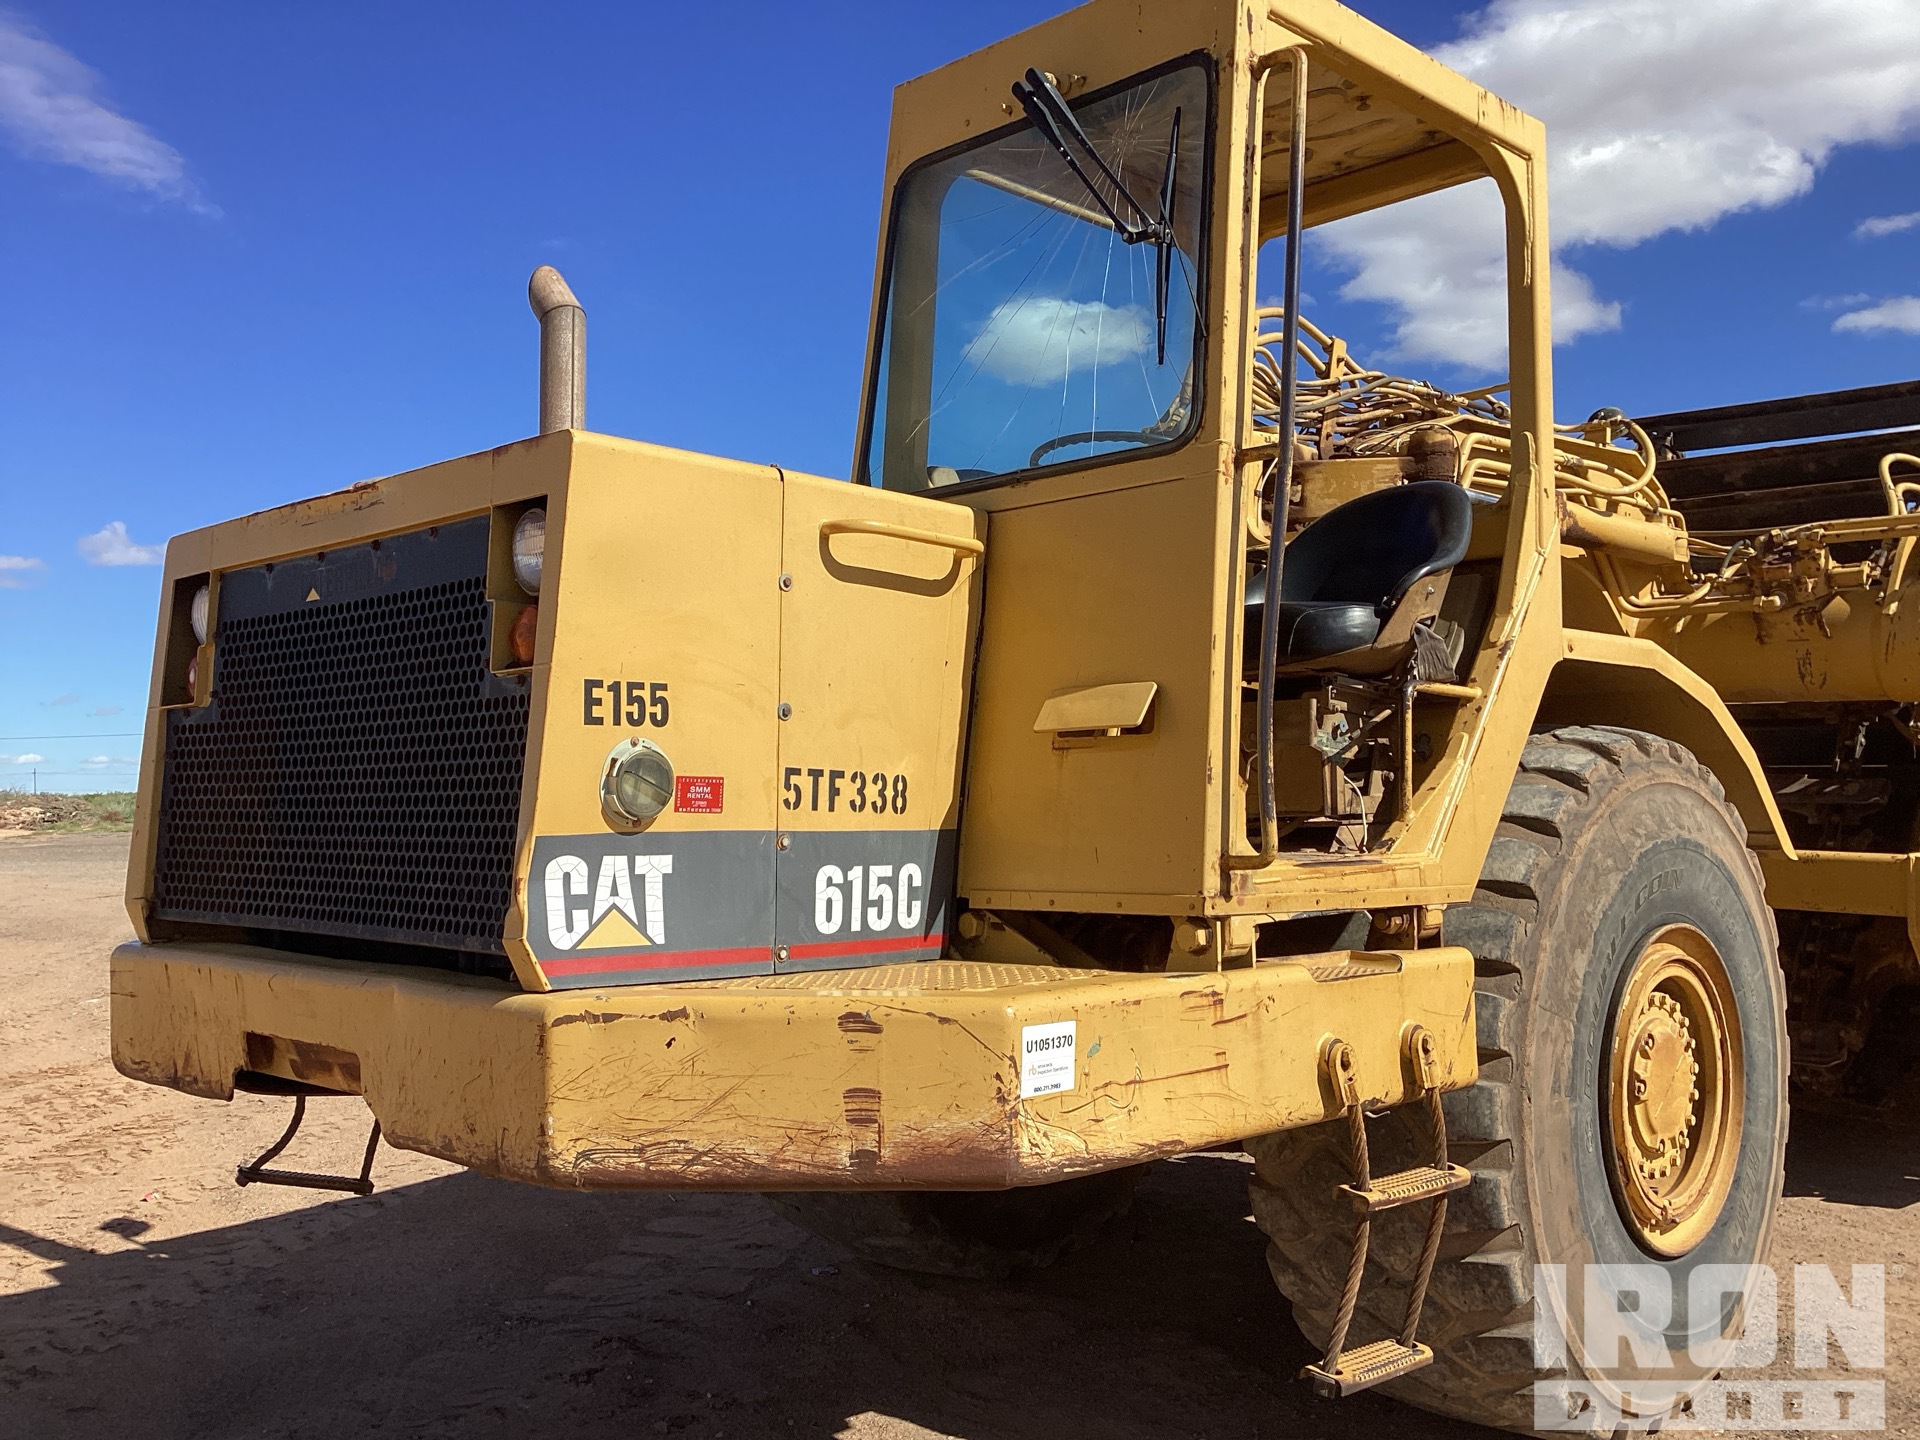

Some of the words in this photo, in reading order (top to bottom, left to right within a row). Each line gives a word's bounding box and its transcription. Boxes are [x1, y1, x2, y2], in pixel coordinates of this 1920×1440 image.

[583, 678, 669, 727] E155
[689, 785, 711, 794] SMM
[782, 767, 908, 815] 5TF338
[544, 854, 673, 951] CAT
[814, 862, 922, 935] 615C
[1026, 1034, 1073, 1053] U1051370
